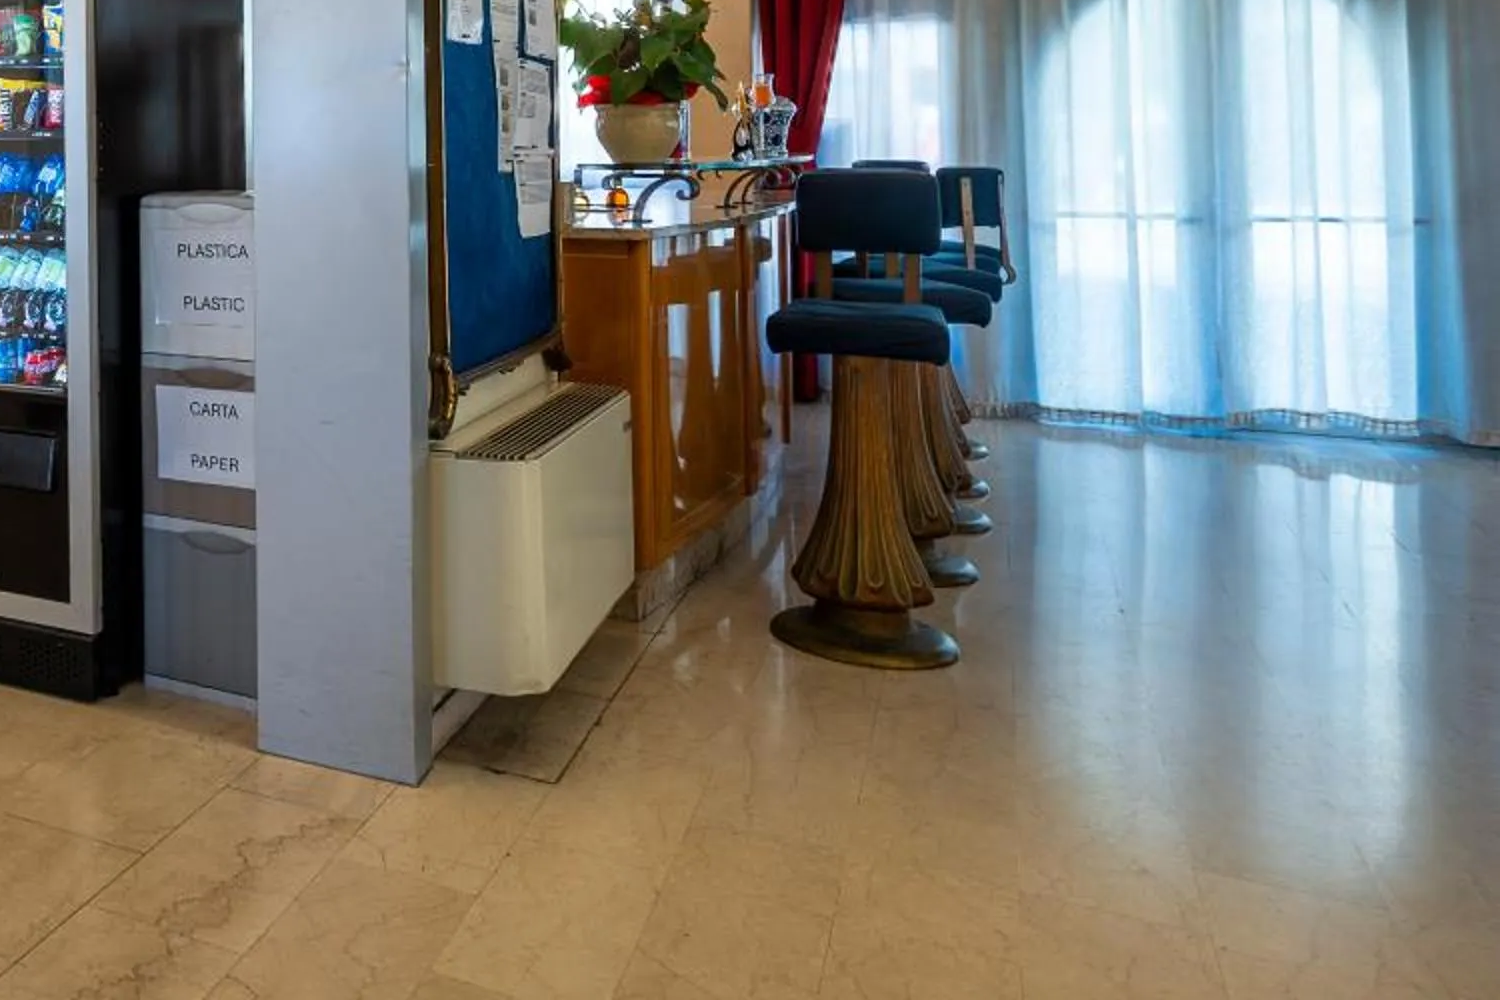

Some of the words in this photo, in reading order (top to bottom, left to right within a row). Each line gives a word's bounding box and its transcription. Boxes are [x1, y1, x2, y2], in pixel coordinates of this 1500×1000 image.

[176, 243, 249, 260] PLASTICA
[183, 295, 245, 312] PLASTIC
[189, 401, 239, 420] CARTA
[190, 454, 239, 473] PAPER
